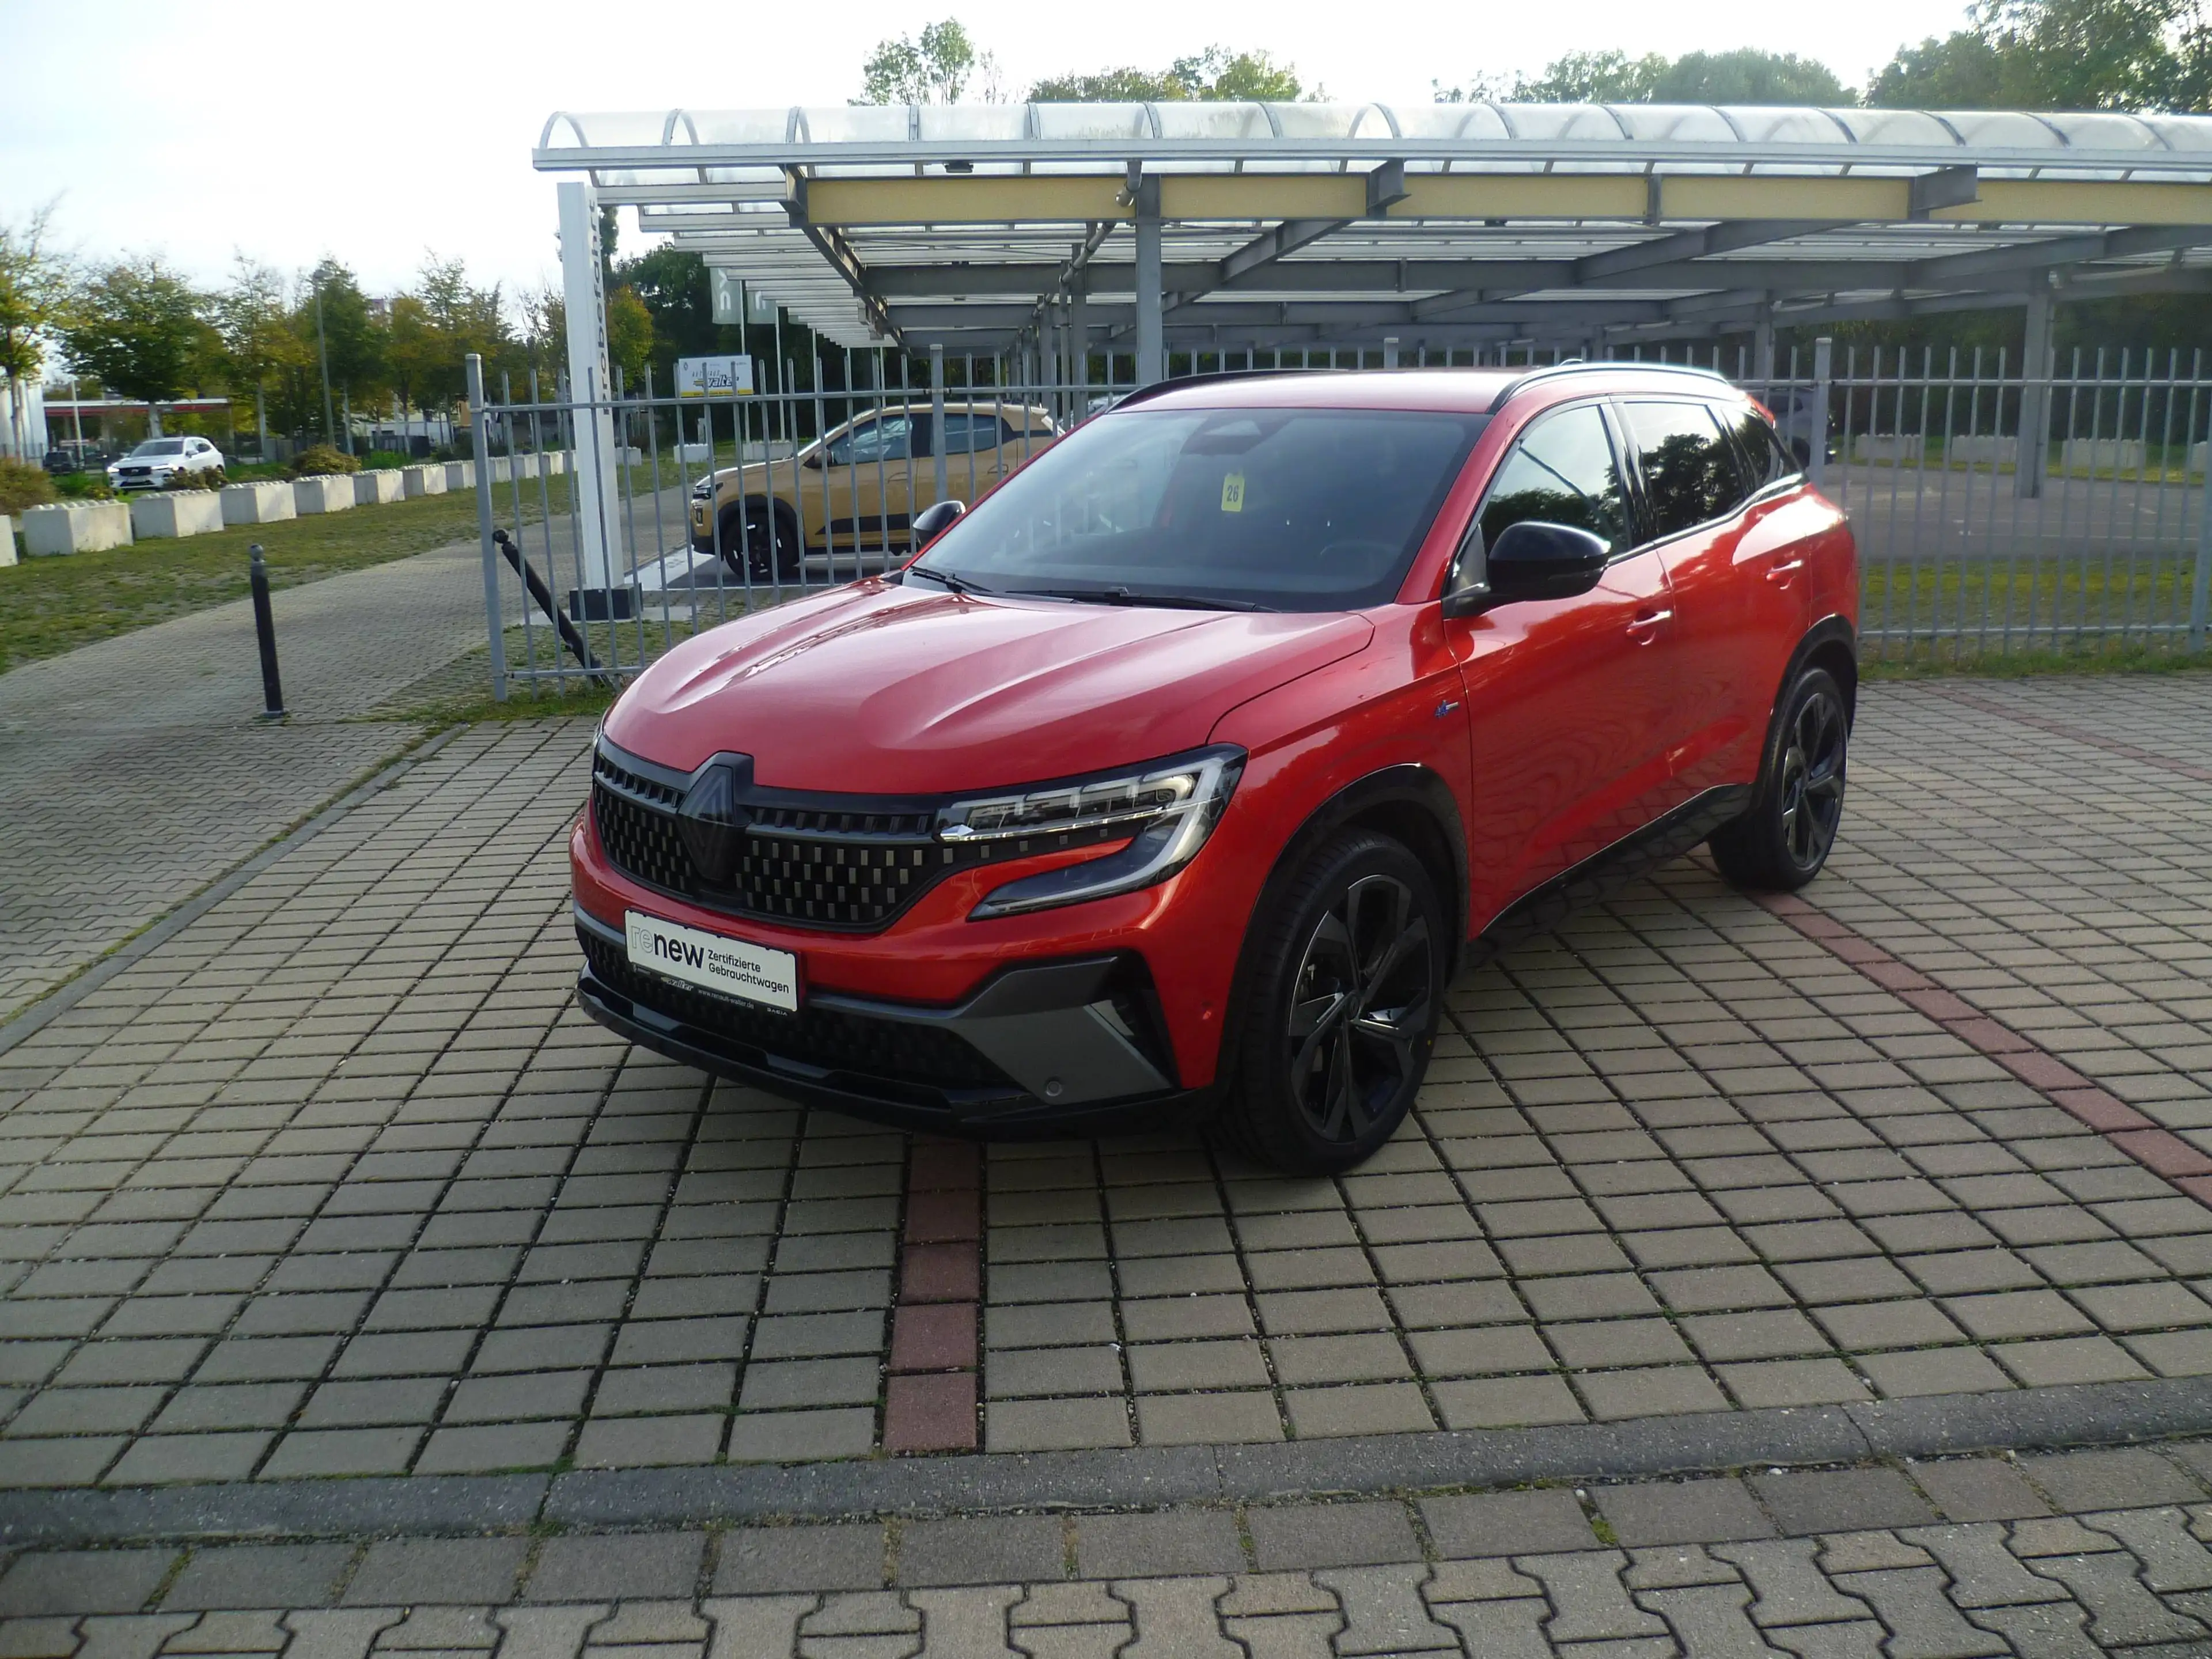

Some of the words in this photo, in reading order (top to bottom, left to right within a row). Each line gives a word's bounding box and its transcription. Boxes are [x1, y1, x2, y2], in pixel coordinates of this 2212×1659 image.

[1227, 485, 1238, 502] 26
[631, 926, 704, 968] renew
[708, 949, 761, 973] Zertifizierte
[709, 963, 790, 994] Gebrauchtwagen
